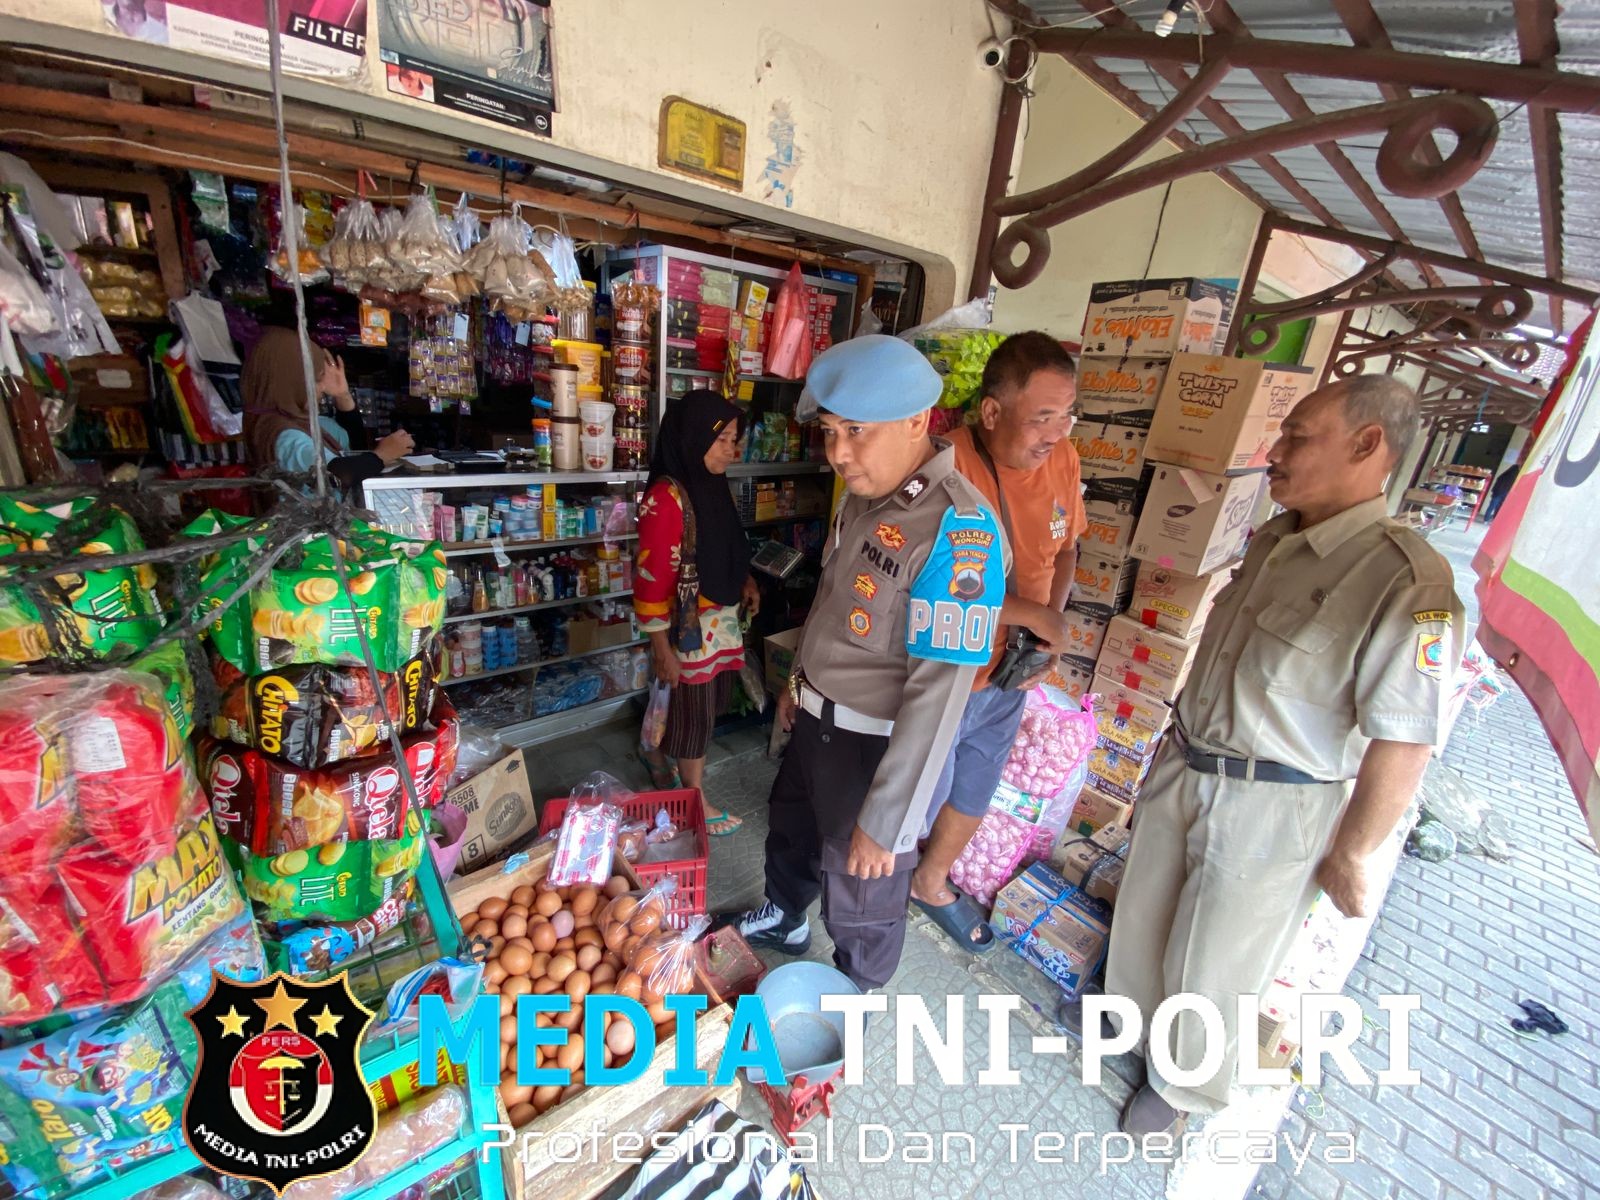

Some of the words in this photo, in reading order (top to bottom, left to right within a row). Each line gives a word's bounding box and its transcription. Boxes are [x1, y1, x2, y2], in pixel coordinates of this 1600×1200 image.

[1178, 372, 1238, 394] TWIST
[1178, 388, 1224, 409] CORN
[951, 530, 992, 542] POLRES
[954, 537, 990, 548] WONOGIRI
[860, 540, 900, 578] POLRI
[1154, 601, 1185, 616] SPECIAL
[211, 753, 242, 836] Qtela
[365, 765, 401, 840] Qtela
[467, 842, 479, 860] 8
[163, 855, 221, 925] POTATO
[172, 898, 207, 932] KENTANG
